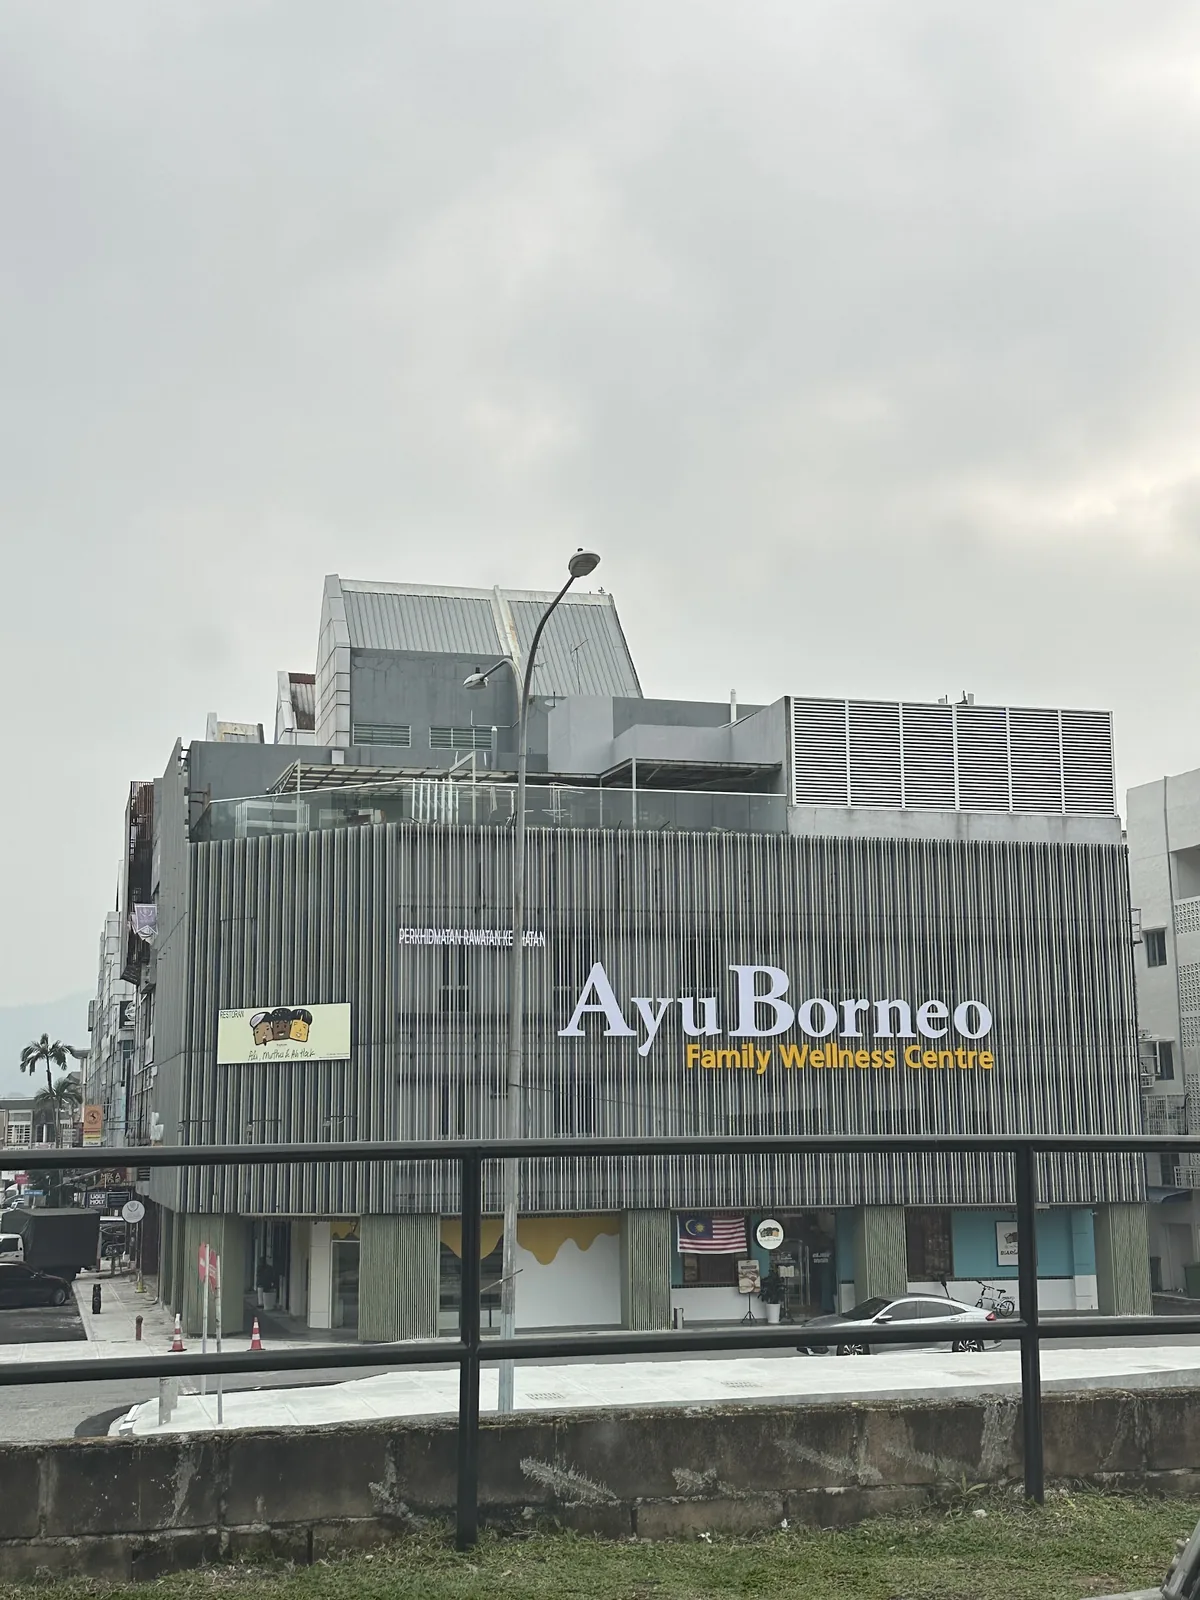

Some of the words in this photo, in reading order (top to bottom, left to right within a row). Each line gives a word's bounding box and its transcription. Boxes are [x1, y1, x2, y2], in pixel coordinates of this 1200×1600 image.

[399, 928, 462, 945] PERKHIDMATAN
[463, 929, 501, 946] RAWATAN
[557, 961, 993, 1057] AyuBorneo
[686, 1043, 772, 1075] Family
[779, 1042, 896, 1070] Wellness
[904, 1044, 995, 1070] Centre
